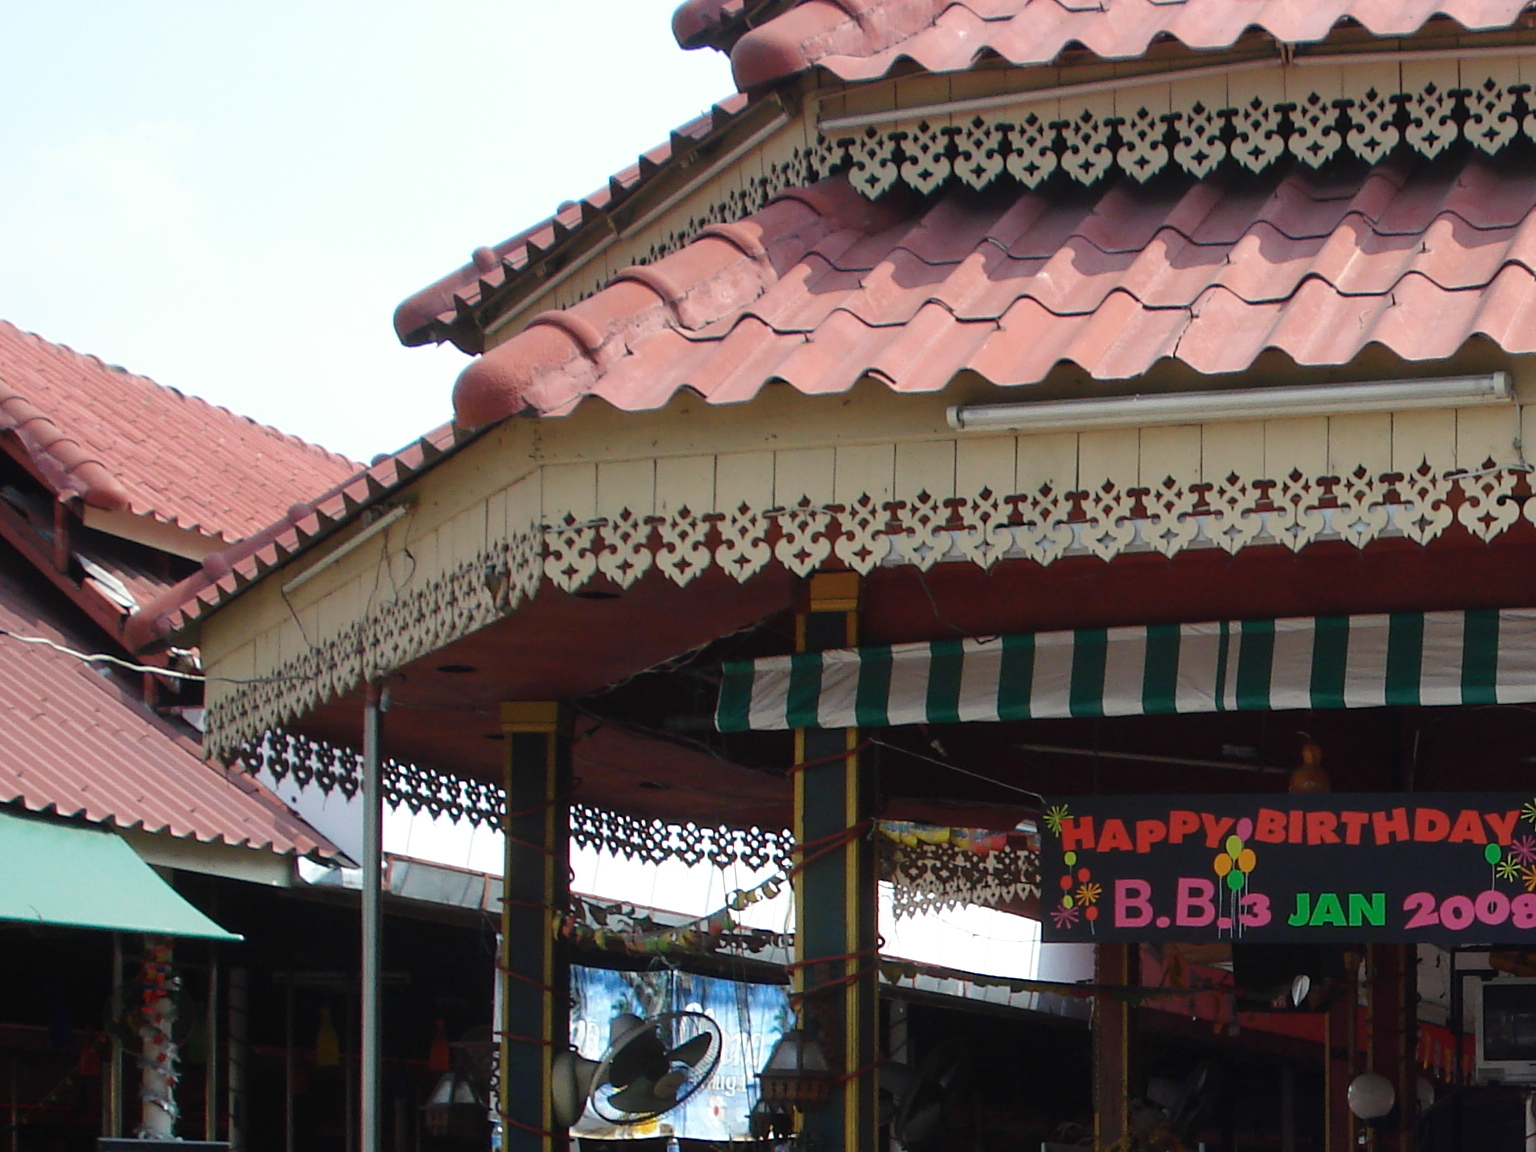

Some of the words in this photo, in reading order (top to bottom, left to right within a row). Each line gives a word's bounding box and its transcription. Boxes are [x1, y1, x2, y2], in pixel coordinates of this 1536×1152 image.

[1060, 810, 1235, 853] HAPPY
[1254, 808, 1522, 846] BIRTHDAY
[1287, 893, 1386, 927] JAN
